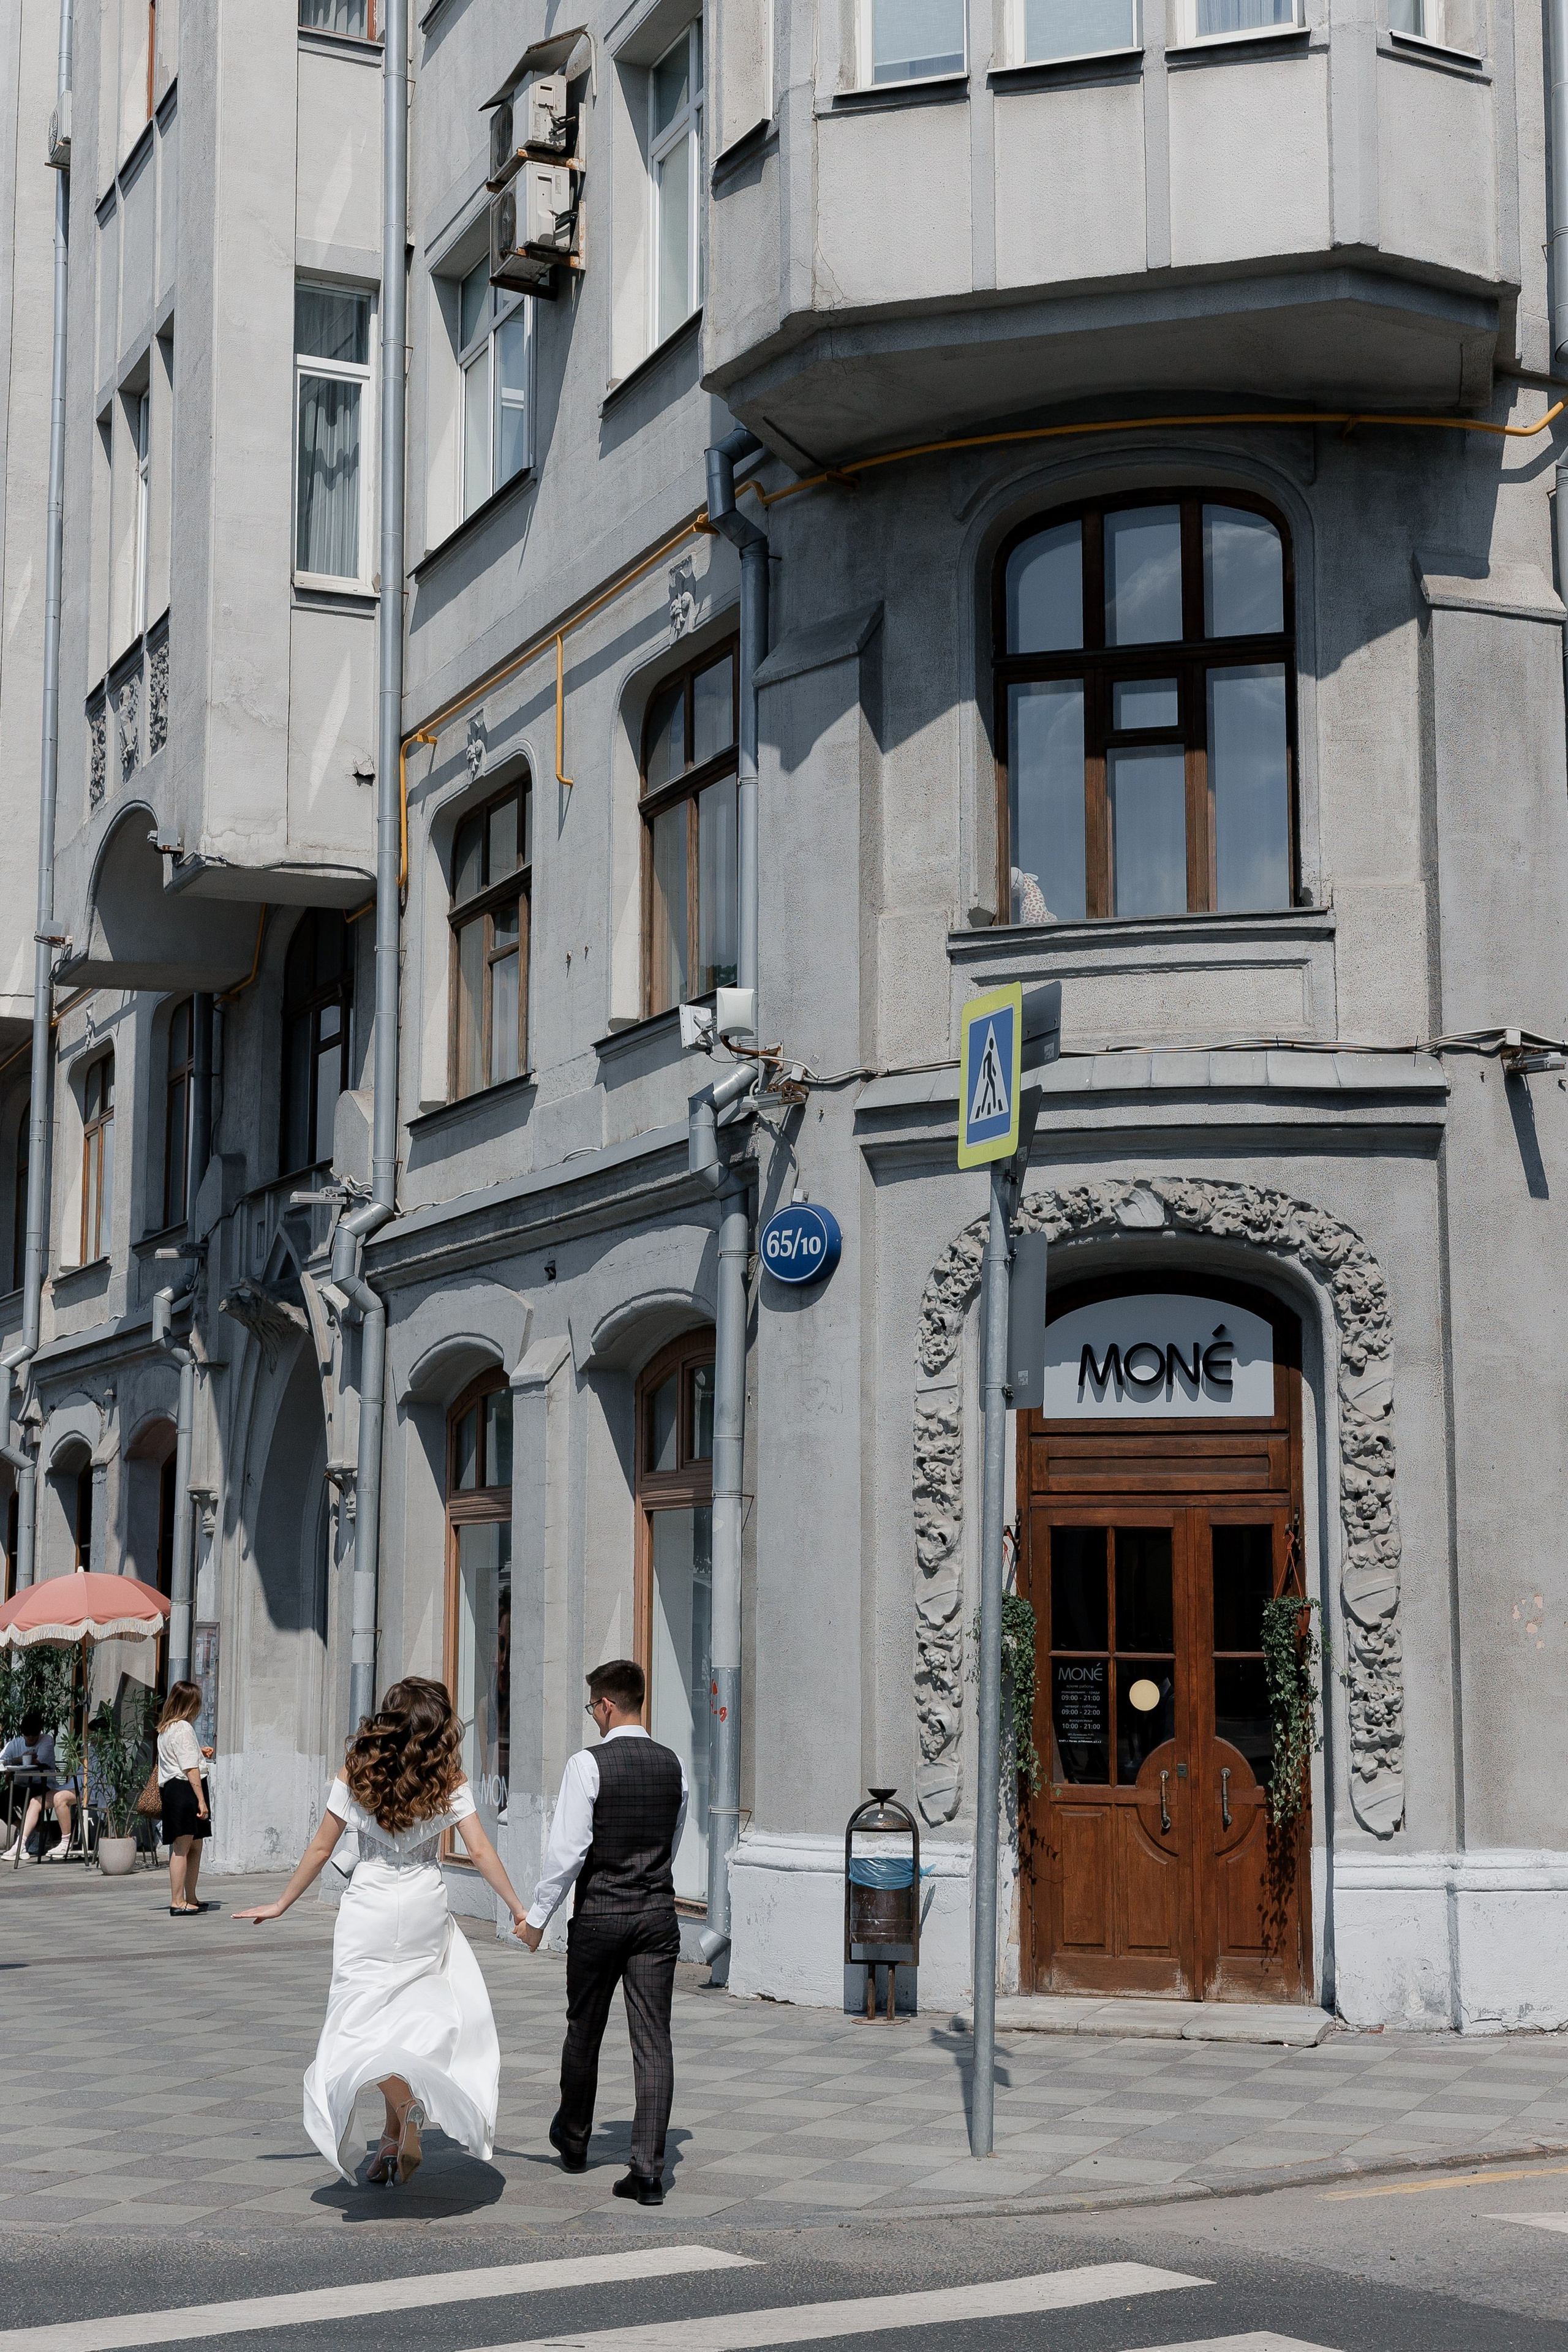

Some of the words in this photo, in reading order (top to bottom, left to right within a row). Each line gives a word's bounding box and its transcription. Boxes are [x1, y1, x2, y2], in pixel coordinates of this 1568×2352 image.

[767, 1227, 821, 1259] 65/10
[1078, 1324, 1234, 1385] MONÉ
[1058, 1662, 1102, 1681] MONÉ
